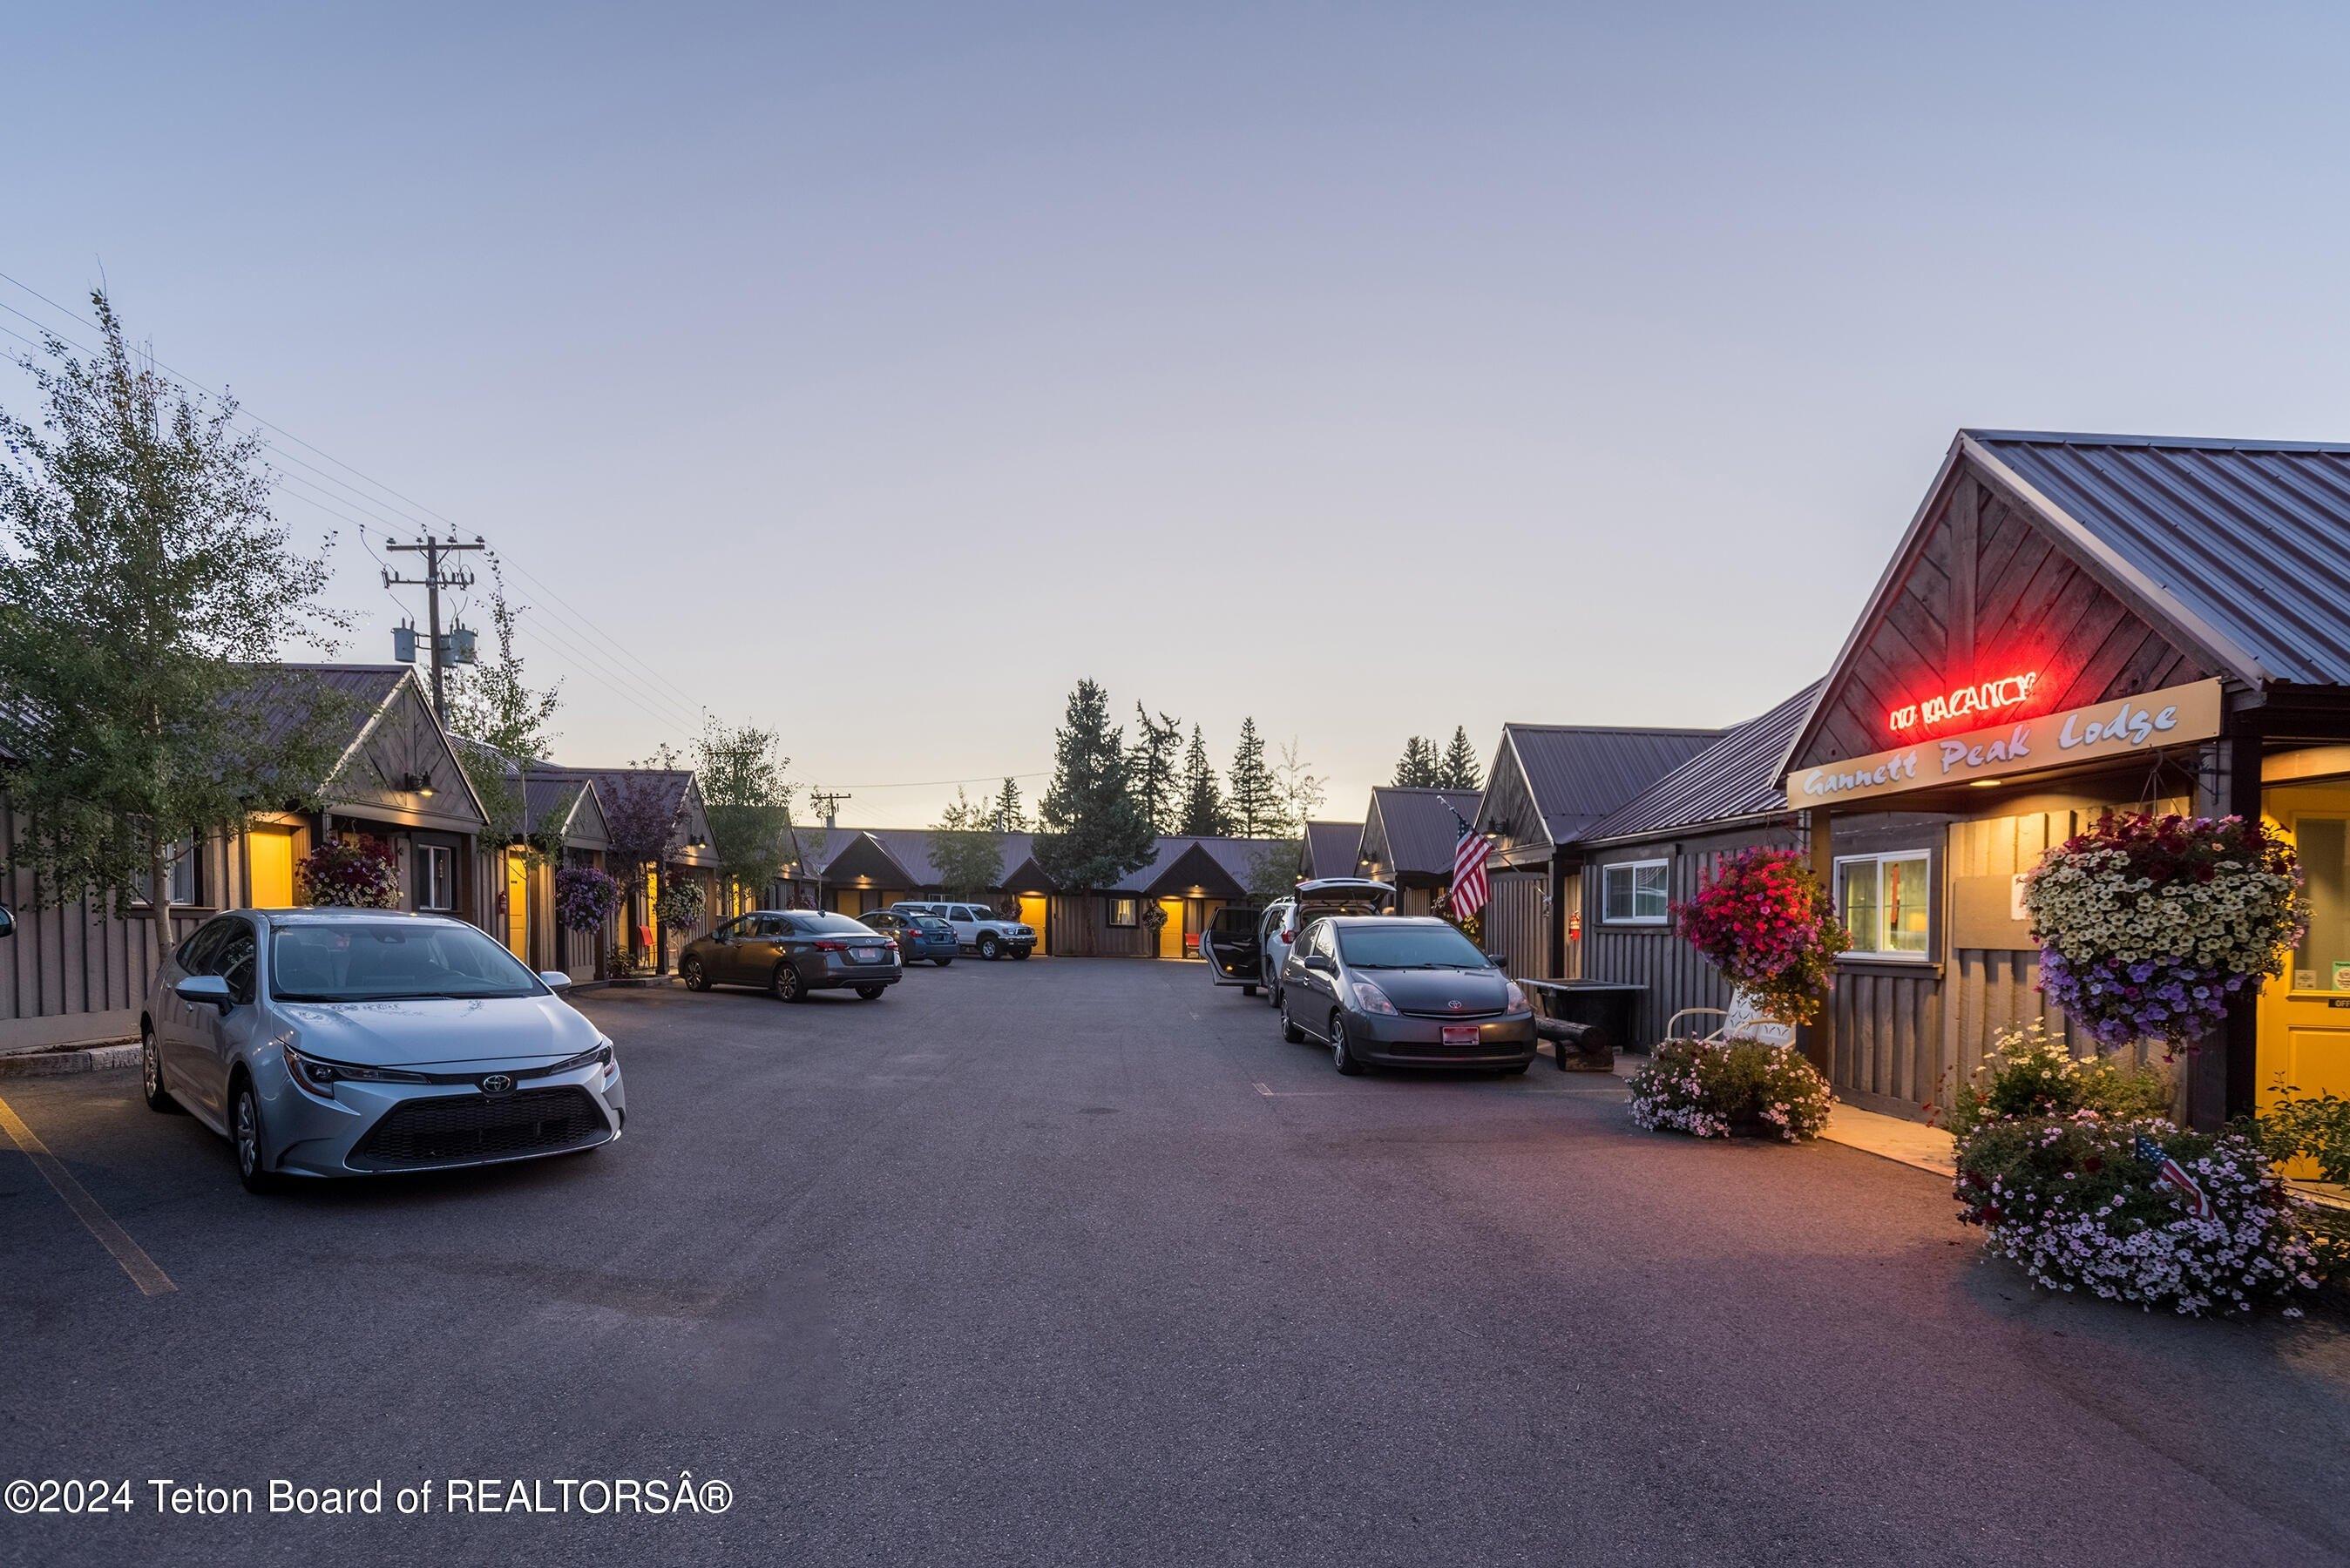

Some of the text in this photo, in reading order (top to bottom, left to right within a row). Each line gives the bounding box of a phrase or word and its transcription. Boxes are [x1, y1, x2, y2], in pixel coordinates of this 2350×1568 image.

[1889, 672, 2036, 730] NO VACANCY
[1802, 704, 2178, 797] Gannett Peak Lodge
